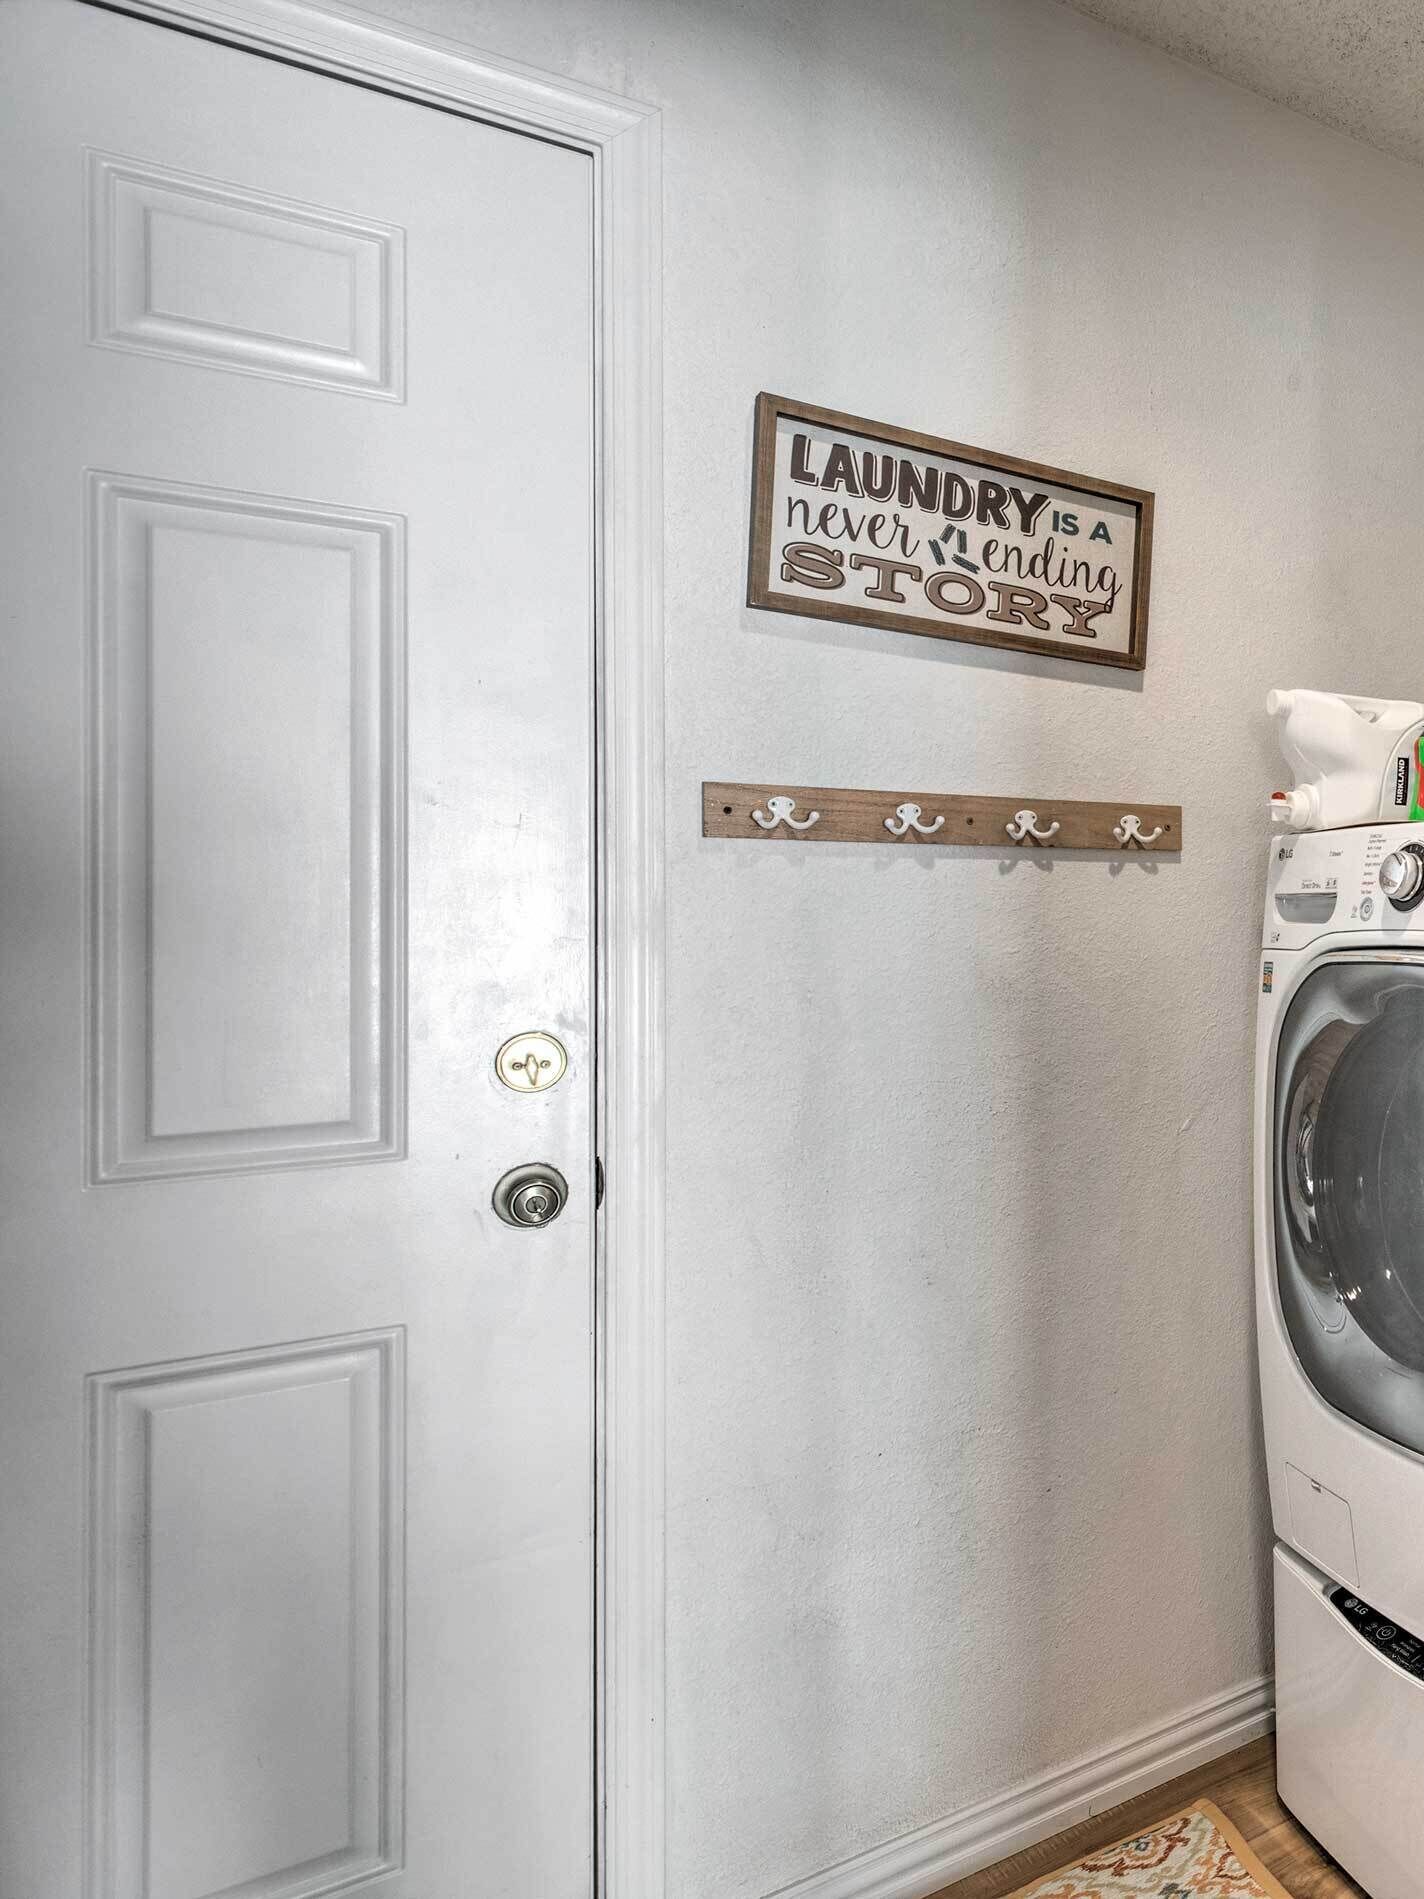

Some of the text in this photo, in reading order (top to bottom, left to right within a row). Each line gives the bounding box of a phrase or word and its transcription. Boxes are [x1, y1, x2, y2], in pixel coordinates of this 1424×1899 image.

[791, 434, 1112, 544] LAUNDRY IS A
[781, 541, 1112, 638] STORY
[787, 496, 1122, 613] never ending
[1395, 759, 1406, 804] KIRKLAND
[1354, 1604, 1369, 1615] LG
